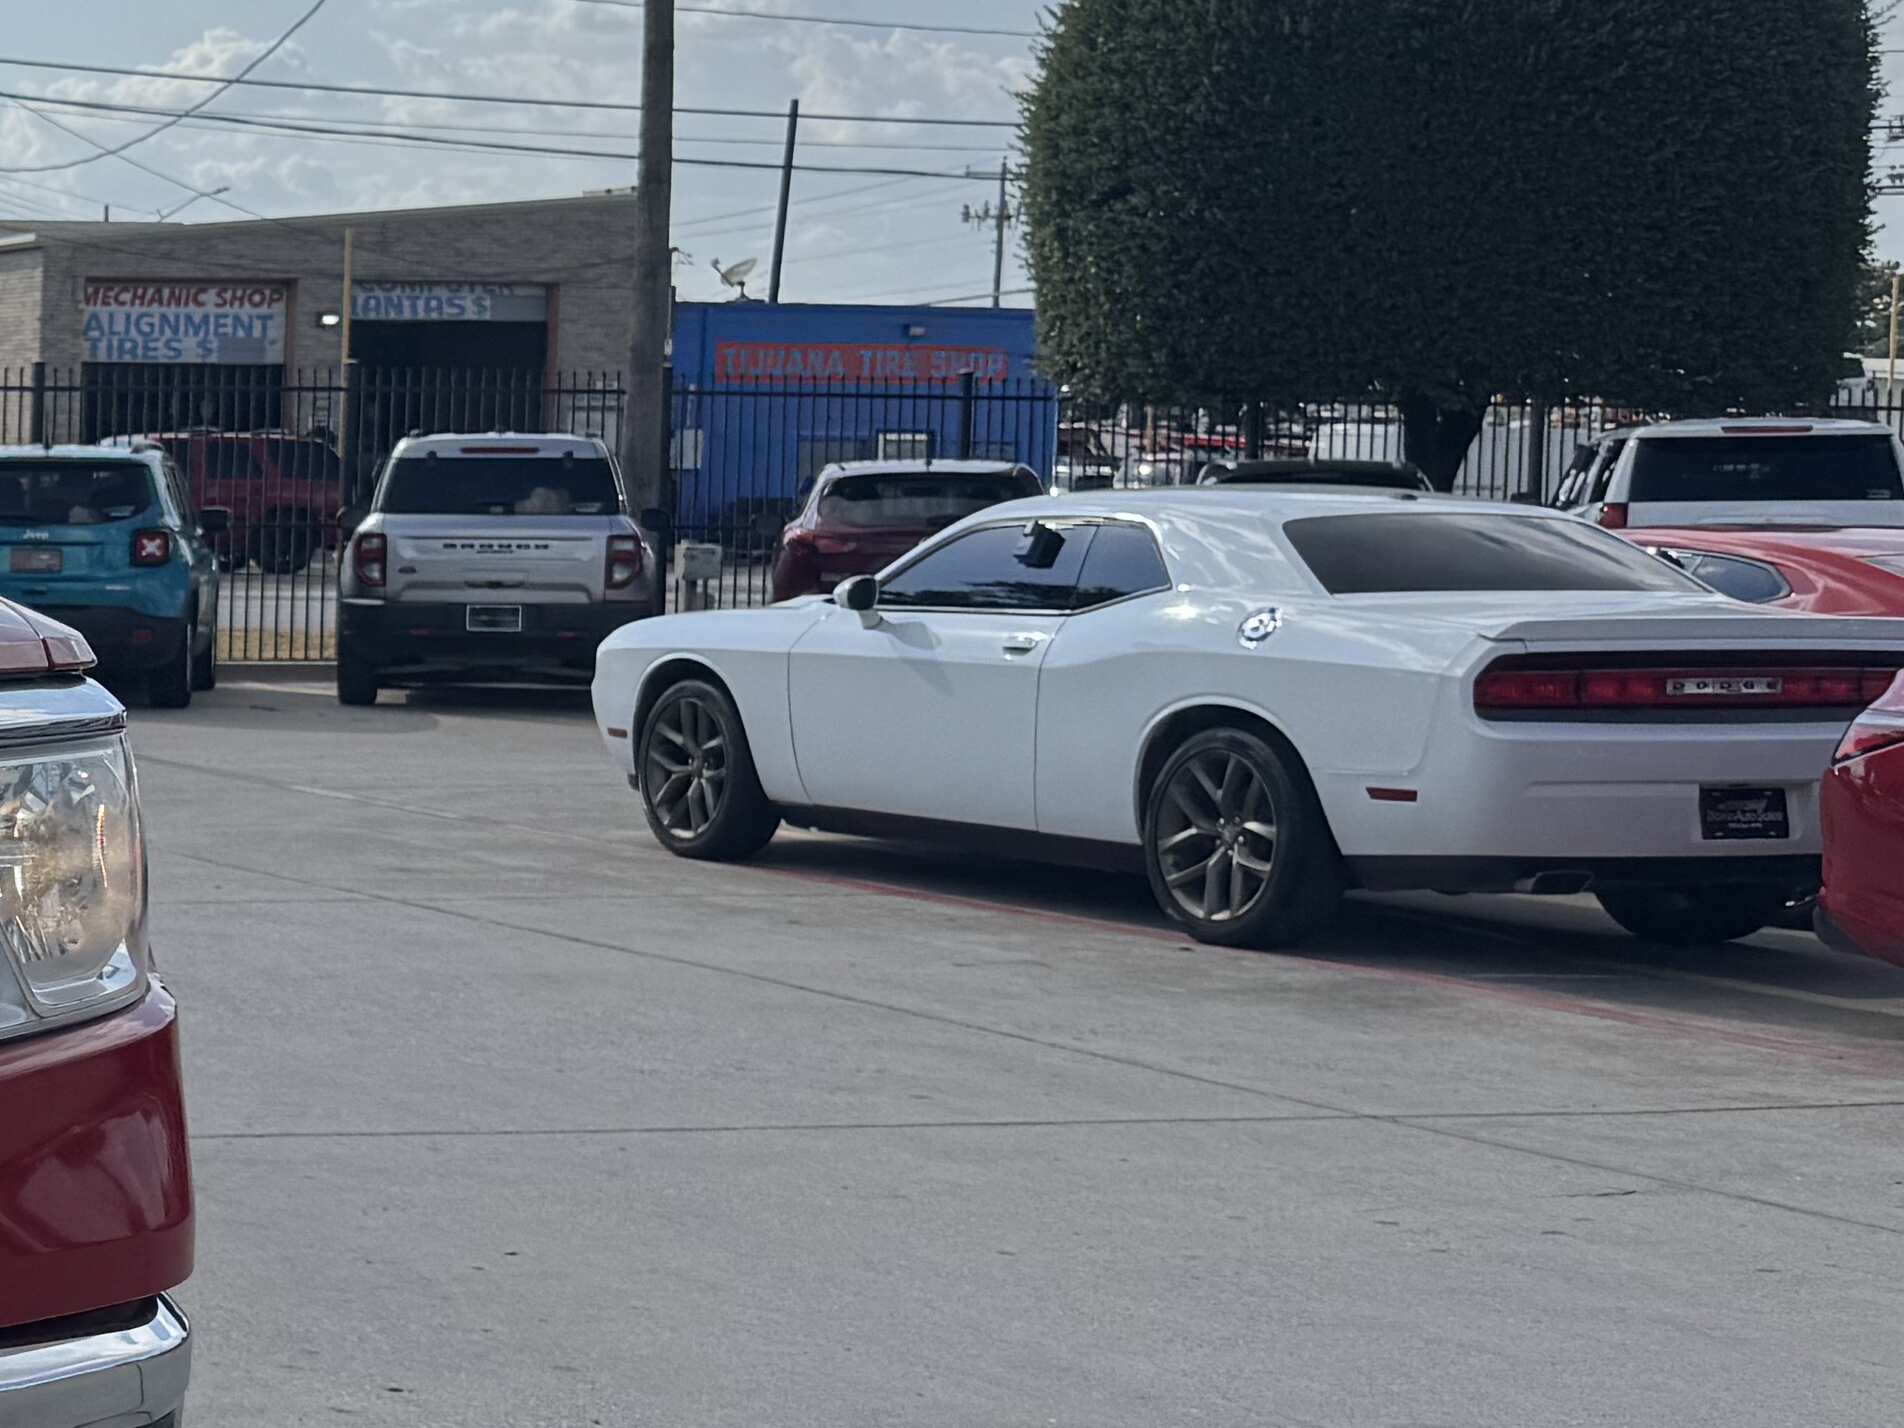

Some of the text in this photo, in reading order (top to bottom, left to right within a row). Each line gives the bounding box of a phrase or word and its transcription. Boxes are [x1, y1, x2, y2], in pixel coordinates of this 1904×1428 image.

[214, 286, 285, 310] SHOP
[83, 312, 274, 339] ALIGNMENT
[85, 337, 183, 360] TIRES
[722, 347, 1008, 381] TIJUANA TIRE SHOP
[1672, 680, 1779, 691] DODGE
